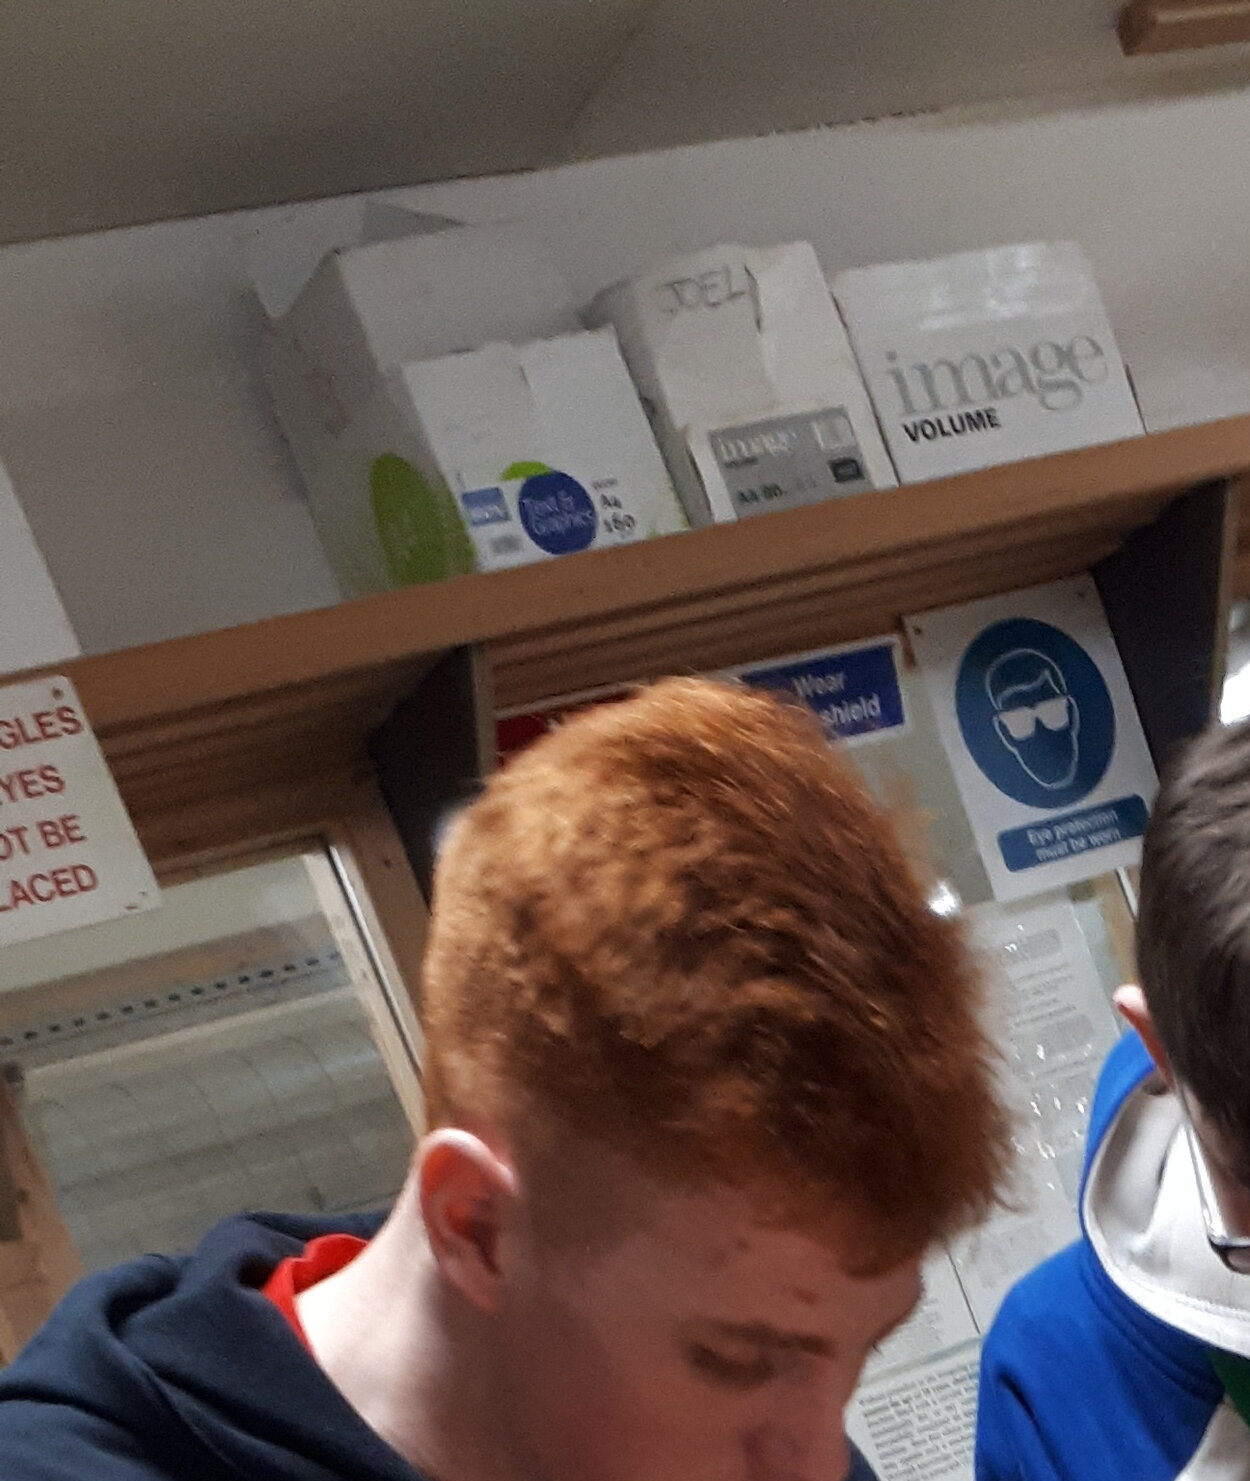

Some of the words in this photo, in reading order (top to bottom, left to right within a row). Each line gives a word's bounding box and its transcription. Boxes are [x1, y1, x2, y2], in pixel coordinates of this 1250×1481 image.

[885, 334, 1109, 415] image
[902, 407, 1002, 443] VOLUME
[792, 671, 847, 698] Wear
[818, 692, 882, 728] shield
[36, 814, 88, 849] BE
